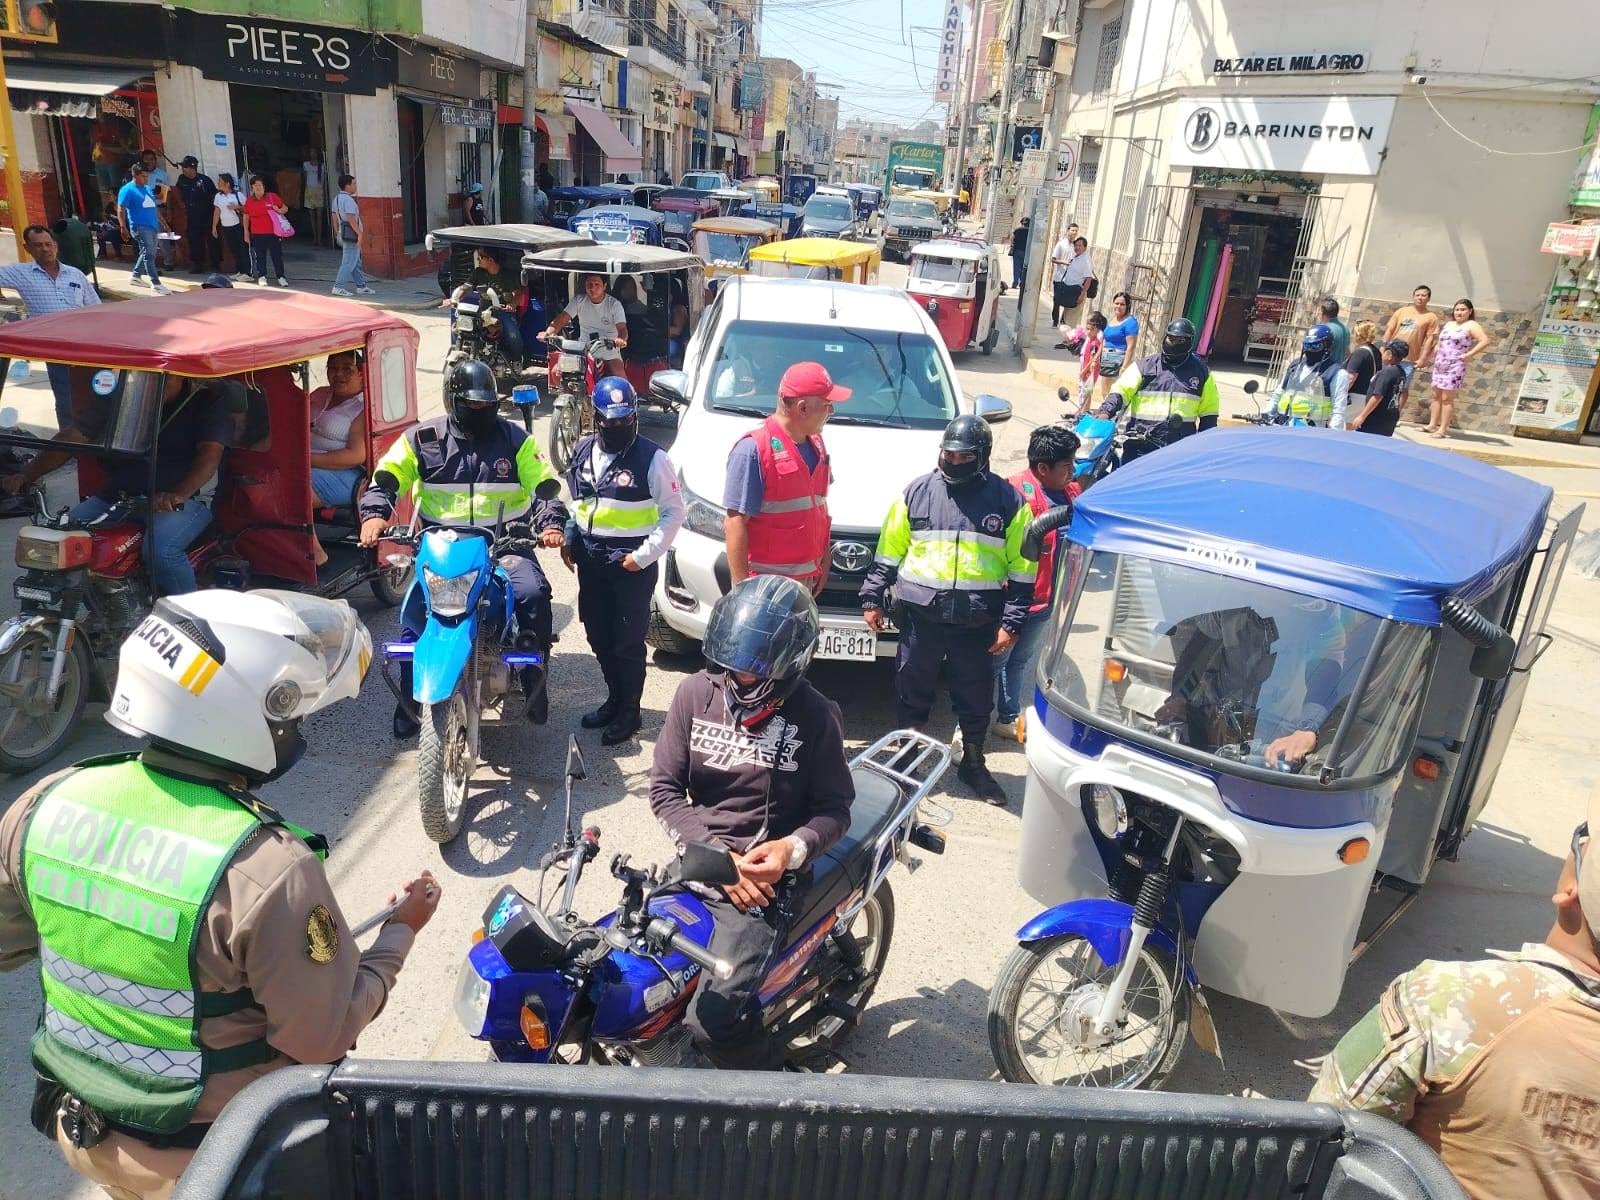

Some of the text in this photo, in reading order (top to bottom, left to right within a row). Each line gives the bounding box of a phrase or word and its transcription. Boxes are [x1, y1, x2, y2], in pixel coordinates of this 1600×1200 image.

[226, 23, 351, 70] PIEERS
[1213, 54, 1364, 72] BAZAR EL MILAGRO
[1224, 122, 1374, 141] BARRINGTON
[44, 804, 189, 889] POLICIA
[32, 866, 177, 936] TRANSITO
